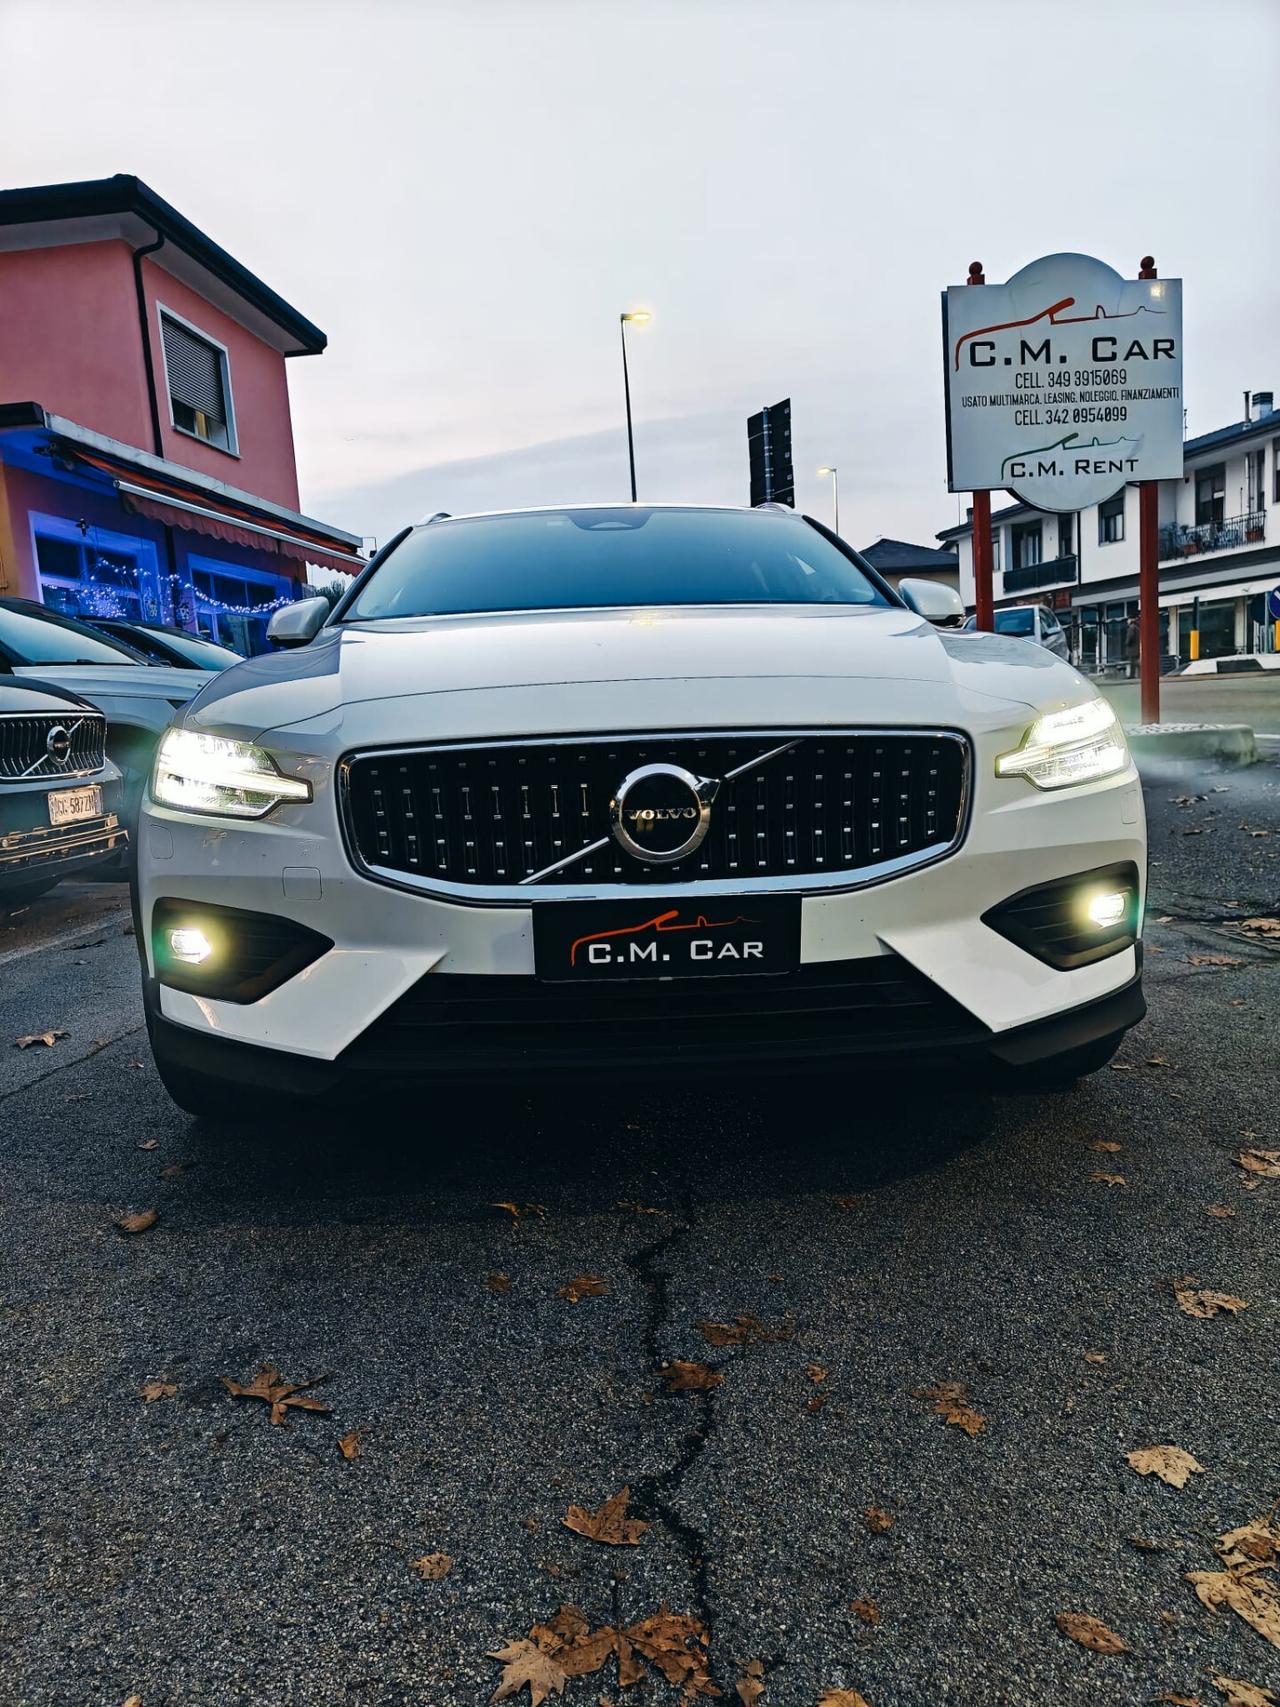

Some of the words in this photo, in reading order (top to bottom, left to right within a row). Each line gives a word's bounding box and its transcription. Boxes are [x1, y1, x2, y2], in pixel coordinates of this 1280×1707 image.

[969, 338, 1067, 367] C.M.
[1015, 372, 1044, 389] CELL.
[1048, 371, 1071, 388] 349
[1074, 368, 1127, 386] 3915069
[961, 395, 987, 408] USATO
[1121, 387, 1179, 401] FINANZIAMENTI
[1014, 409, 1044, 426] CELL.
[1045, 408, 1069, 425] 342
[1073, 406, 1127, 423] 0954099
[1010, 460, 1064, 478] C.M.
[624, 807, 697, 820] VOLVO
[588, 941, 670, 964] C.M.
